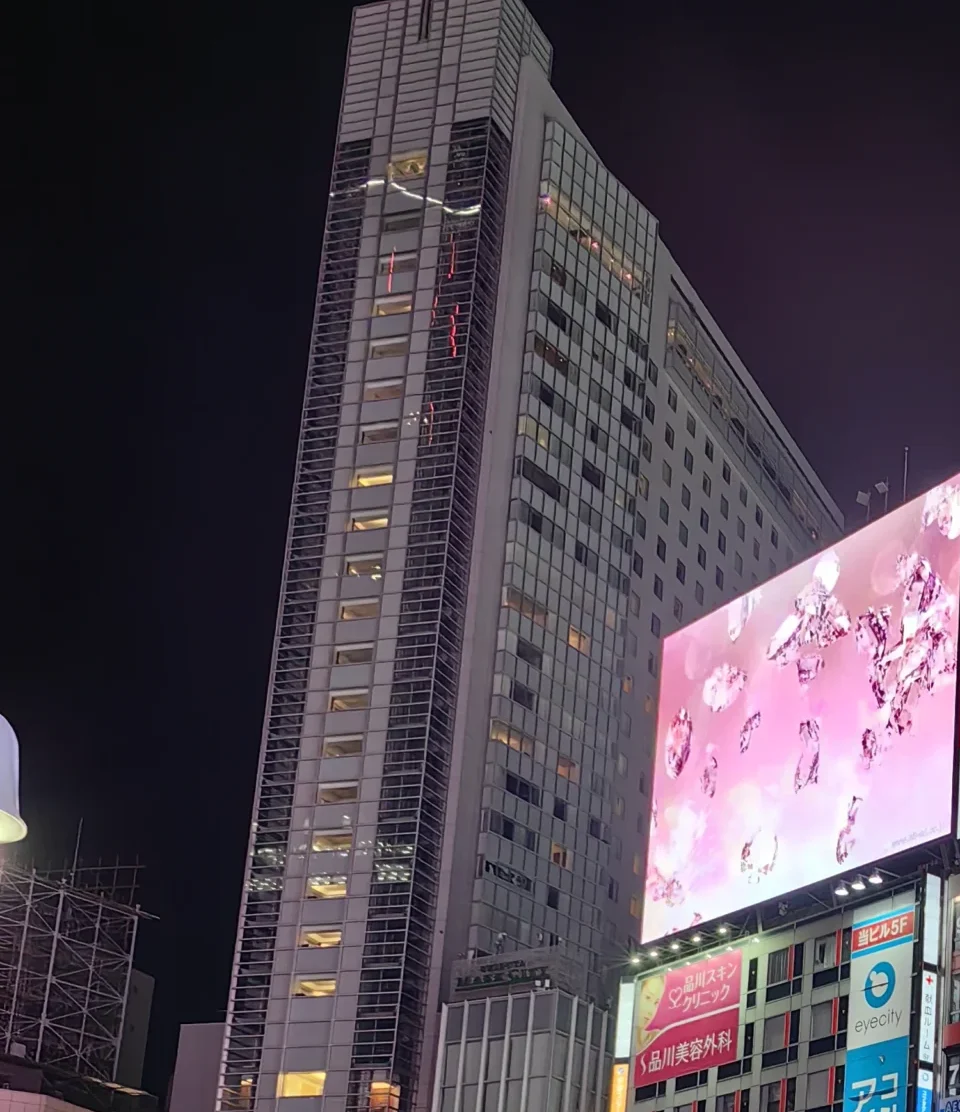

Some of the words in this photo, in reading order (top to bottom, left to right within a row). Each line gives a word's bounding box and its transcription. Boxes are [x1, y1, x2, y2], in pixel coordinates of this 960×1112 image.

[857, 915, 909, 948] 当ビル5F
[683, 962, 738, 994] 品川スキン
[682, 983, 731, 1013] クリニック
[854, 1008, 903, 1036] eyecity
[648, 1028, 733, 1073] 品川美容外科
